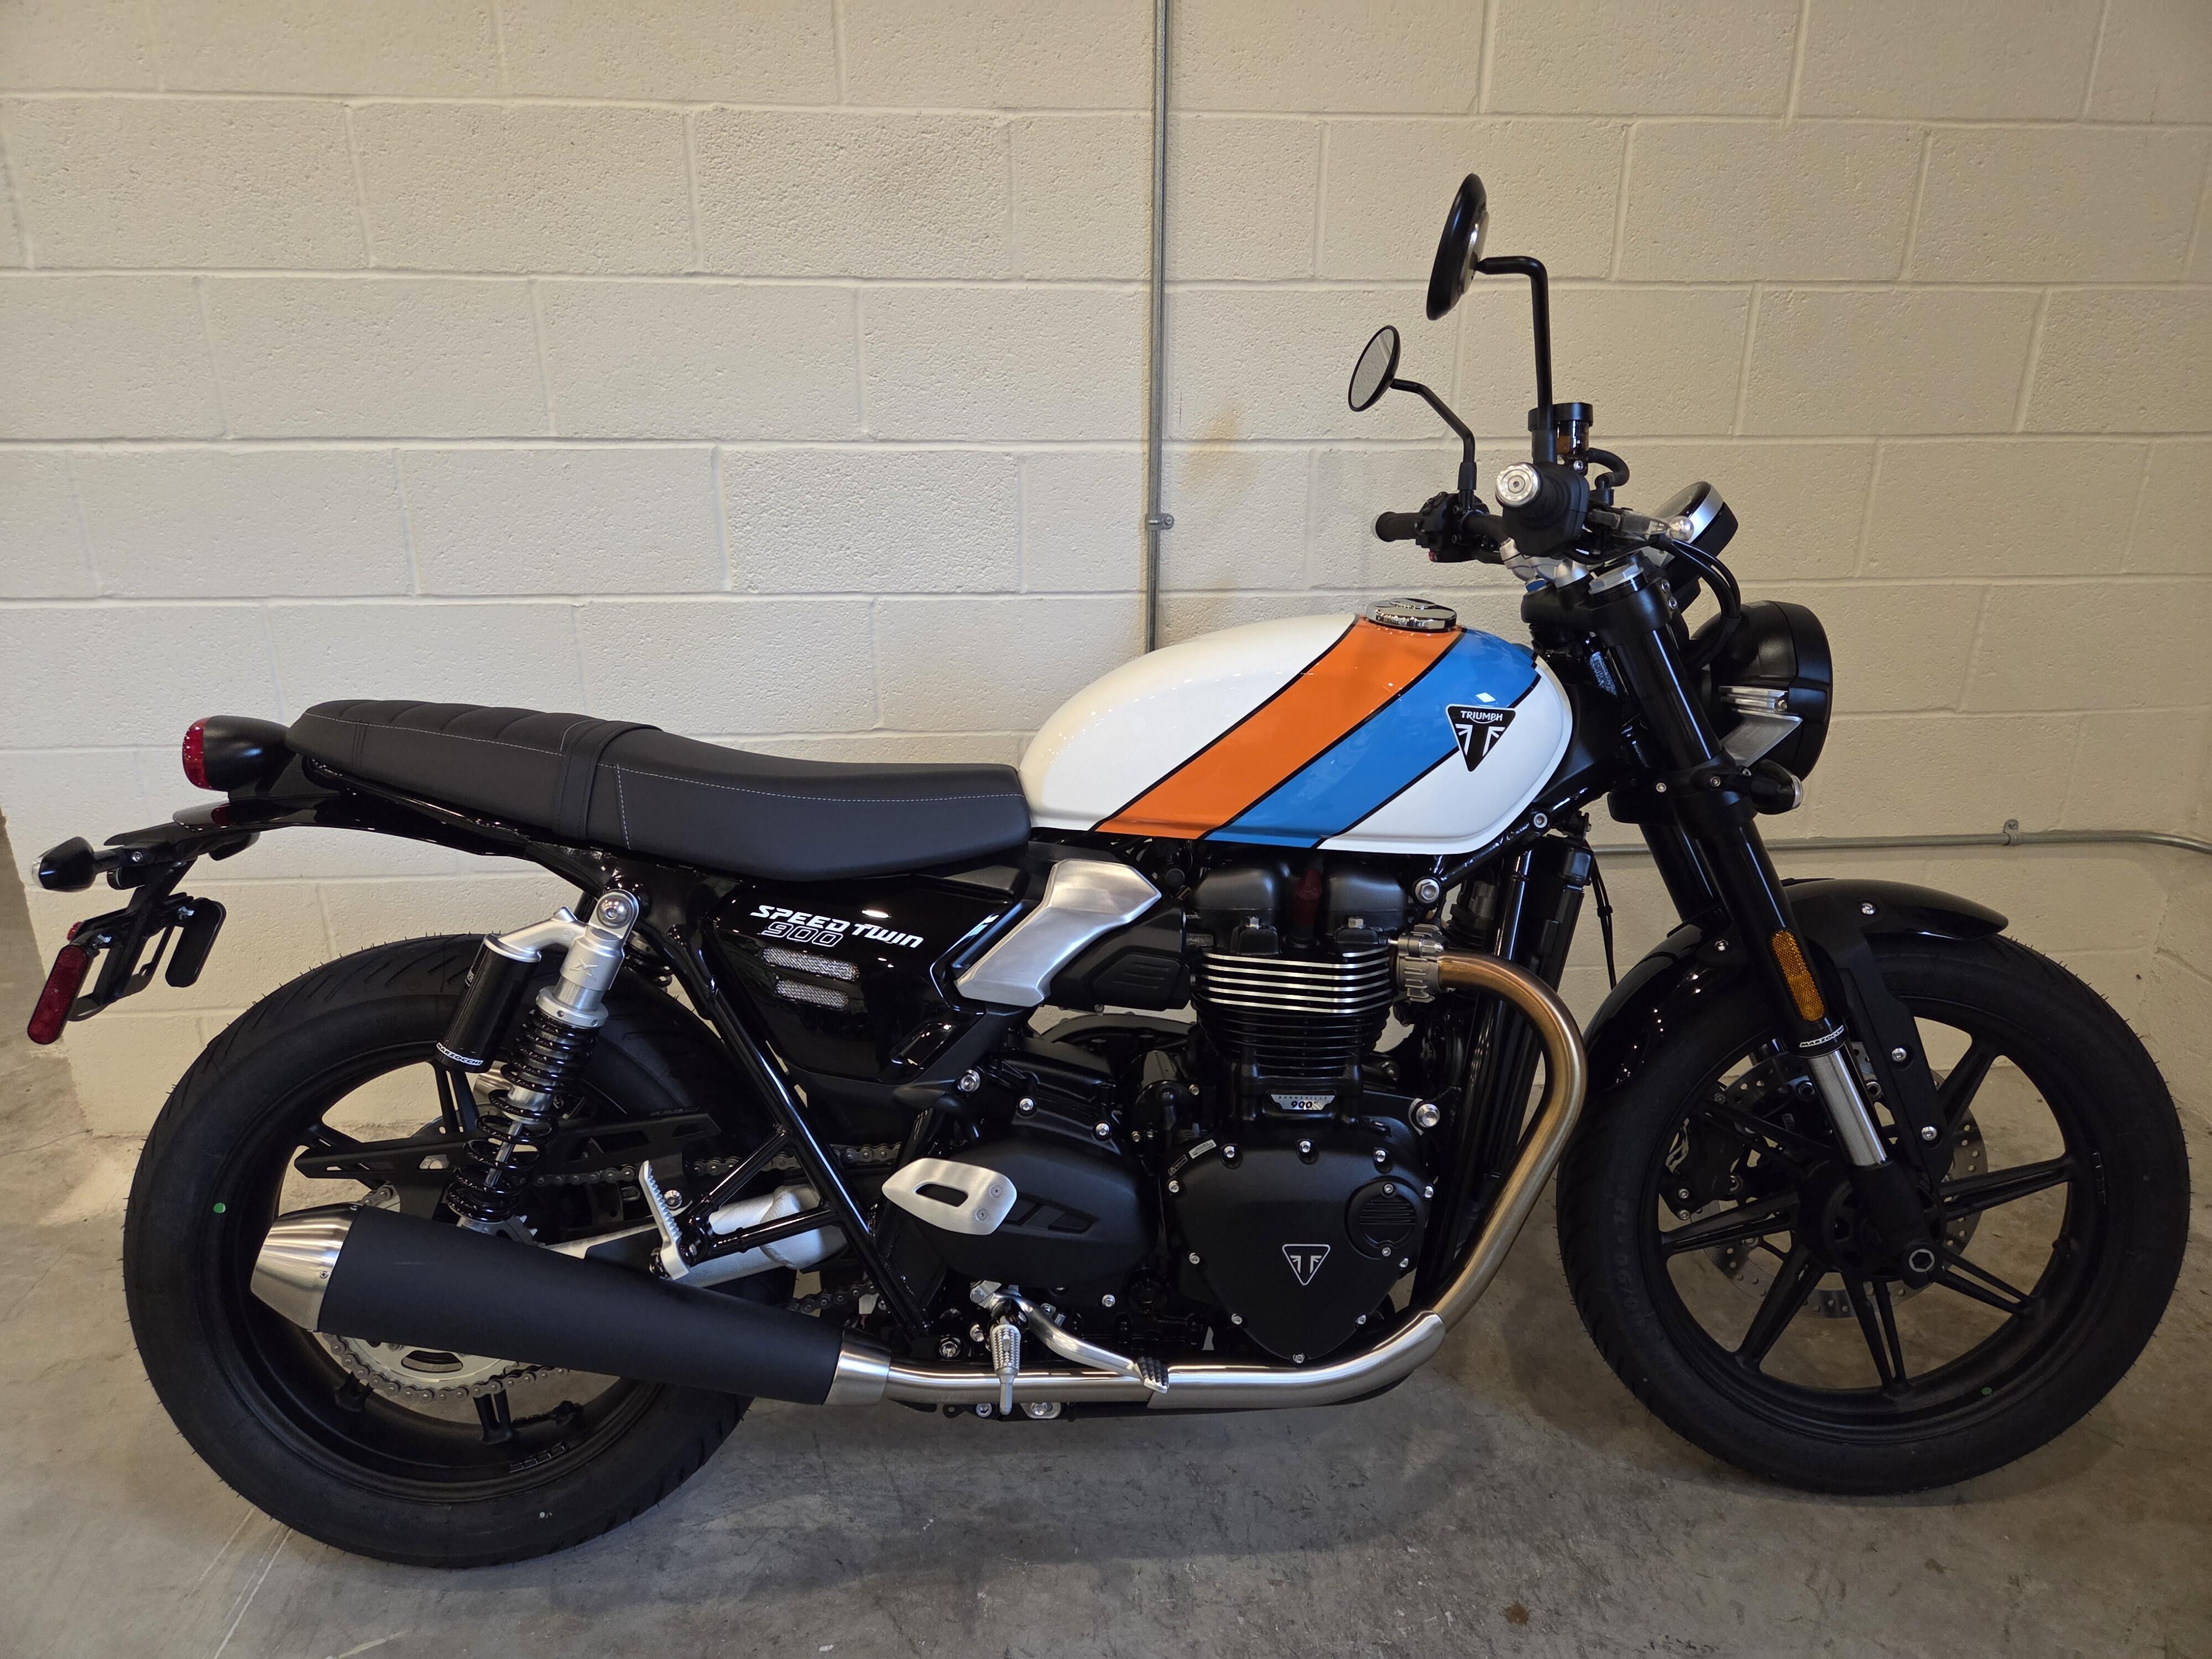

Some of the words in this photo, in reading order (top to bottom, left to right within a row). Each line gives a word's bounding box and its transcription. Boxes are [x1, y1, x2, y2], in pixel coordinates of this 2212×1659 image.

[1460, 710, 1504, 724] TRIUMPH
[750, 905, 851, 933] SPEED
[761, 921, 844, 947] 900
[436, 1042, 484, 1066] MARZOCCHI
[1291, 1100, 1313, 1109] 900
